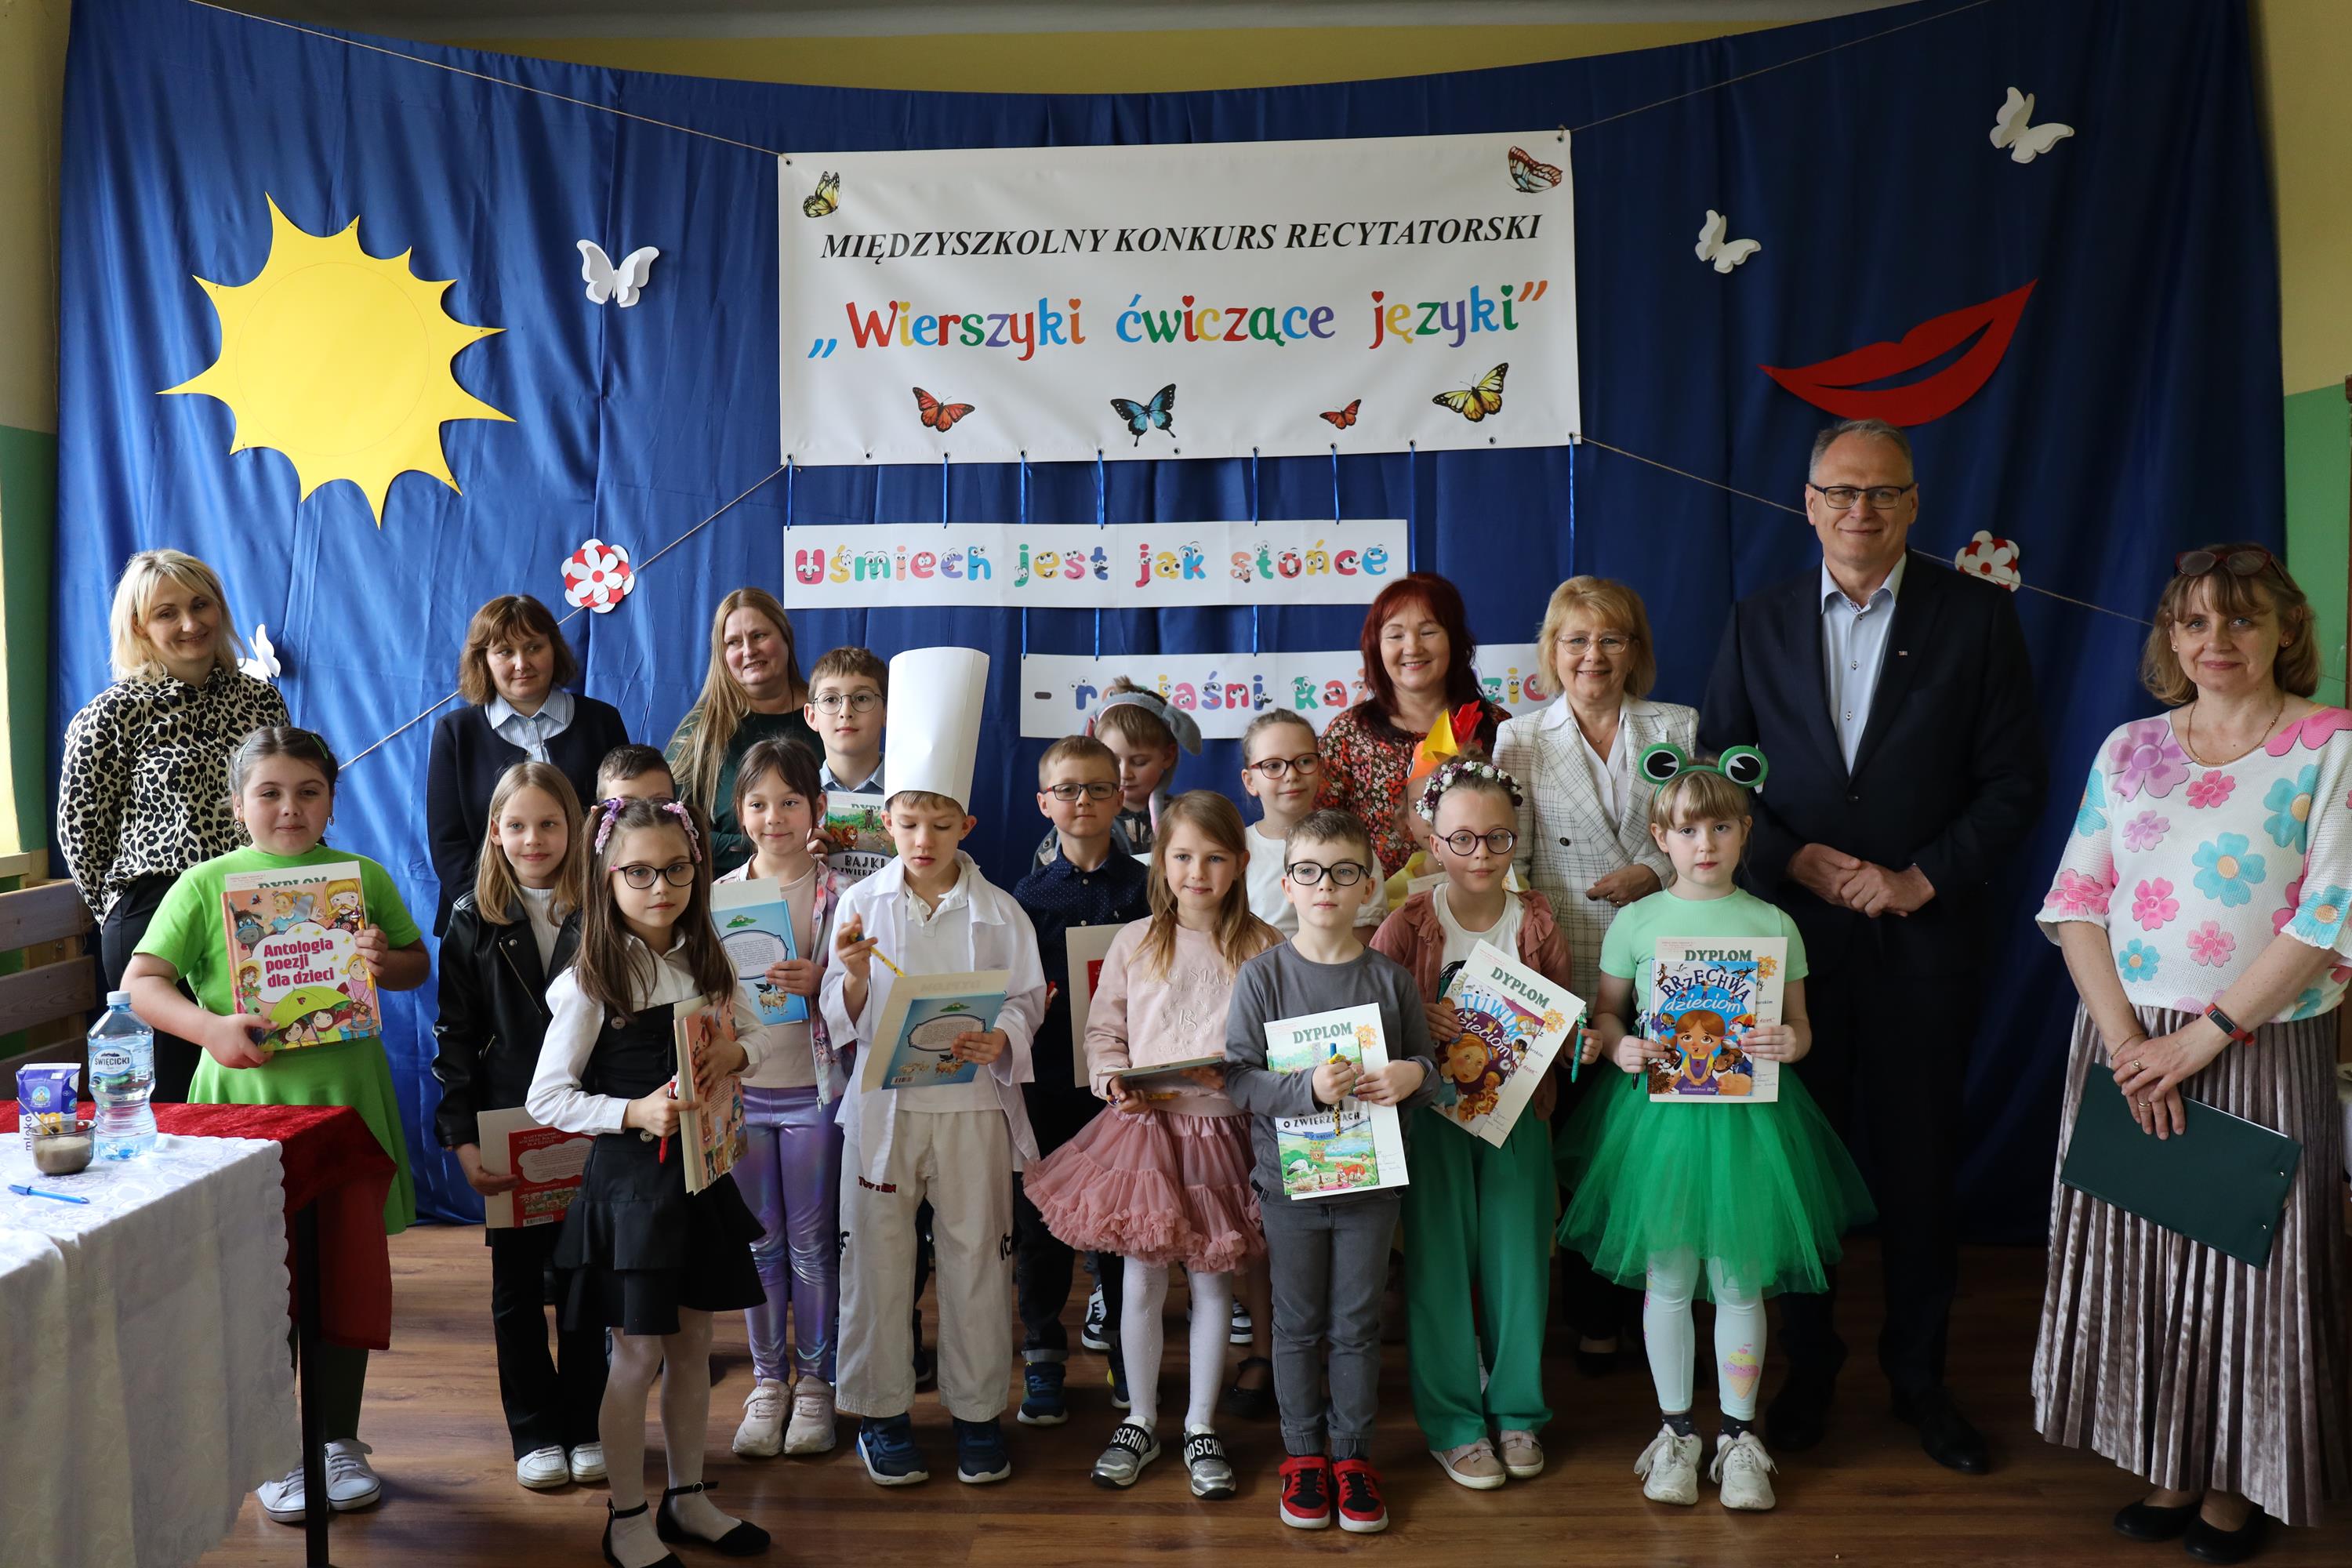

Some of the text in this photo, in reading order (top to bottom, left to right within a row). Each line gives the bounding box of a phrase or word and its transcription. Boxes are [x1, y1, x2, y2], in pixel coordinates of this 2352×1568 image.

[820, 214, 1543, 264] MIĘDZYSZKOLNY KONKURS RECYTATORSKI
[1116, 294, 1335, 347] ćwiczące
[795, 544, 991, 585] Uśmiech
[1013, 543, 1108, 587] jest
[1135, 541, 1206, 587] jak
[844, 855, 885, 869] BAJKI
[264, 938, 334, 957] Antologia
[1685, 949, 1752, 962] DYPLOM
[266, 953, 309, 975] poezji
[267, 967, 335, 988] dla dzieci
[1490, 967, 1550, 1009] DYPLOM
[1661, 969, 1751, 1003] BRZECHWA
[1664, 993, 1740, 1014] dzieciom
[1461, 993, 1523, 1042] TUWIM
[1292, 1022, 1353, 1044] DYPLOM
[94, 1056, 130, 1066] ŚWIĘCICKI
[1294, 1111, 1359, 1127] ZWIERZACH
